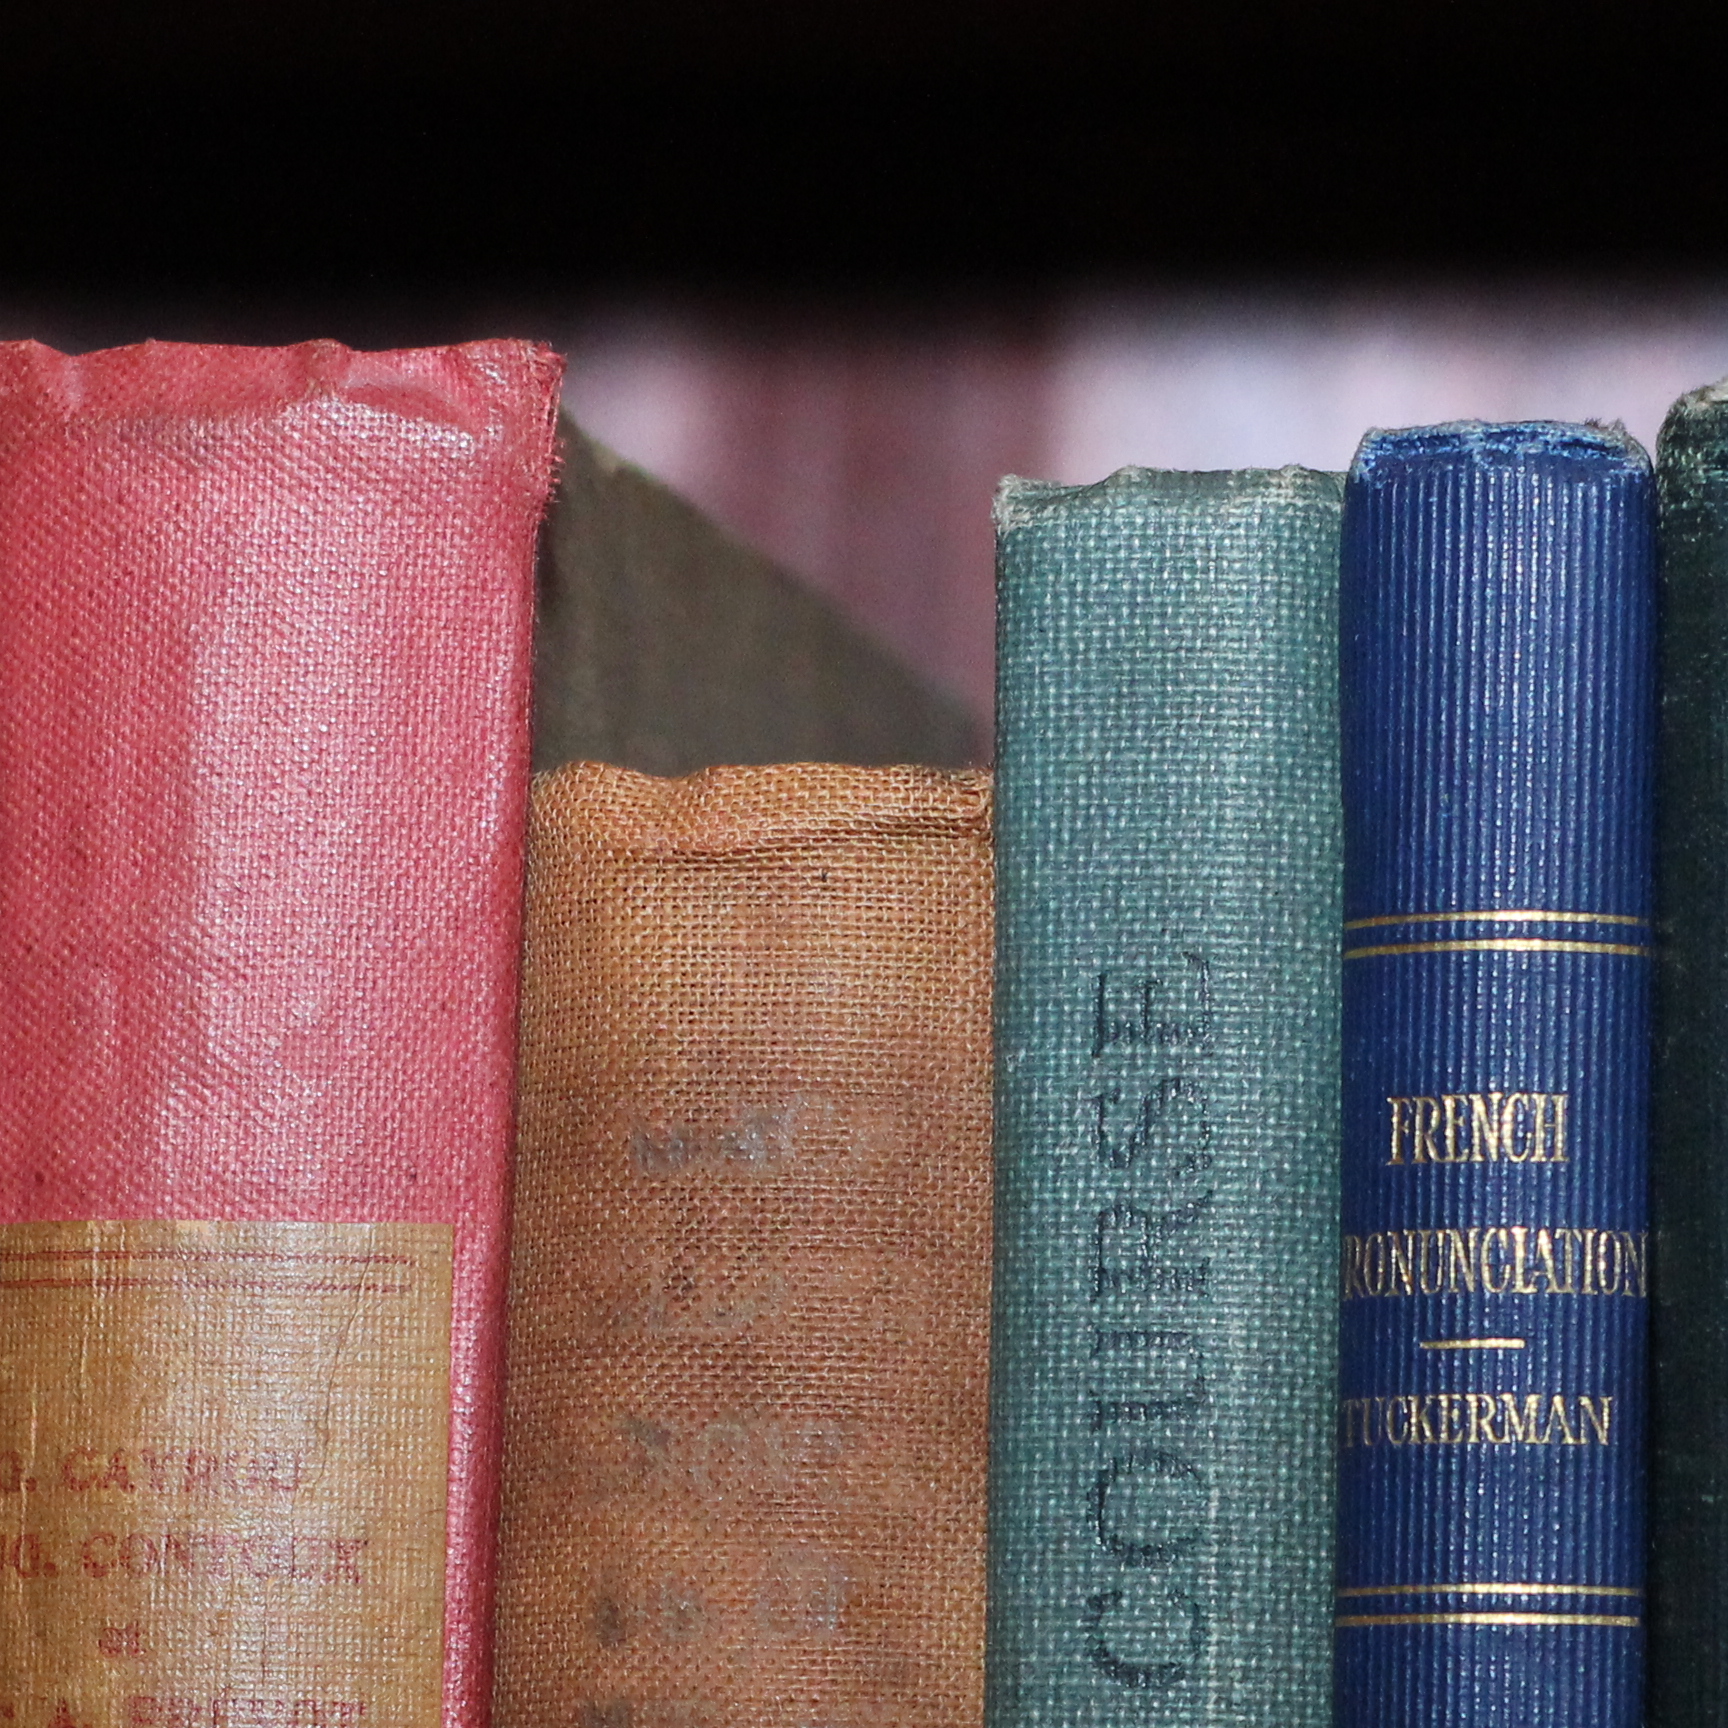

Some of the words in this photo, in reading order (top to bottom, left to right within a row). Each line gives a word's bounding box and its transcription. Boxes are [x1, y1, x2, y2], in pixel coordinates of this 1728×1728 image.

[1384, 1091, 1569, 1166] FRENCH
[1342, 1225, 1649, 1299] RONUNCIATION
[1086, 950, 1215, 1689] COURSE
[1342, 1393, 1613, 1446] TUCKERMAN
